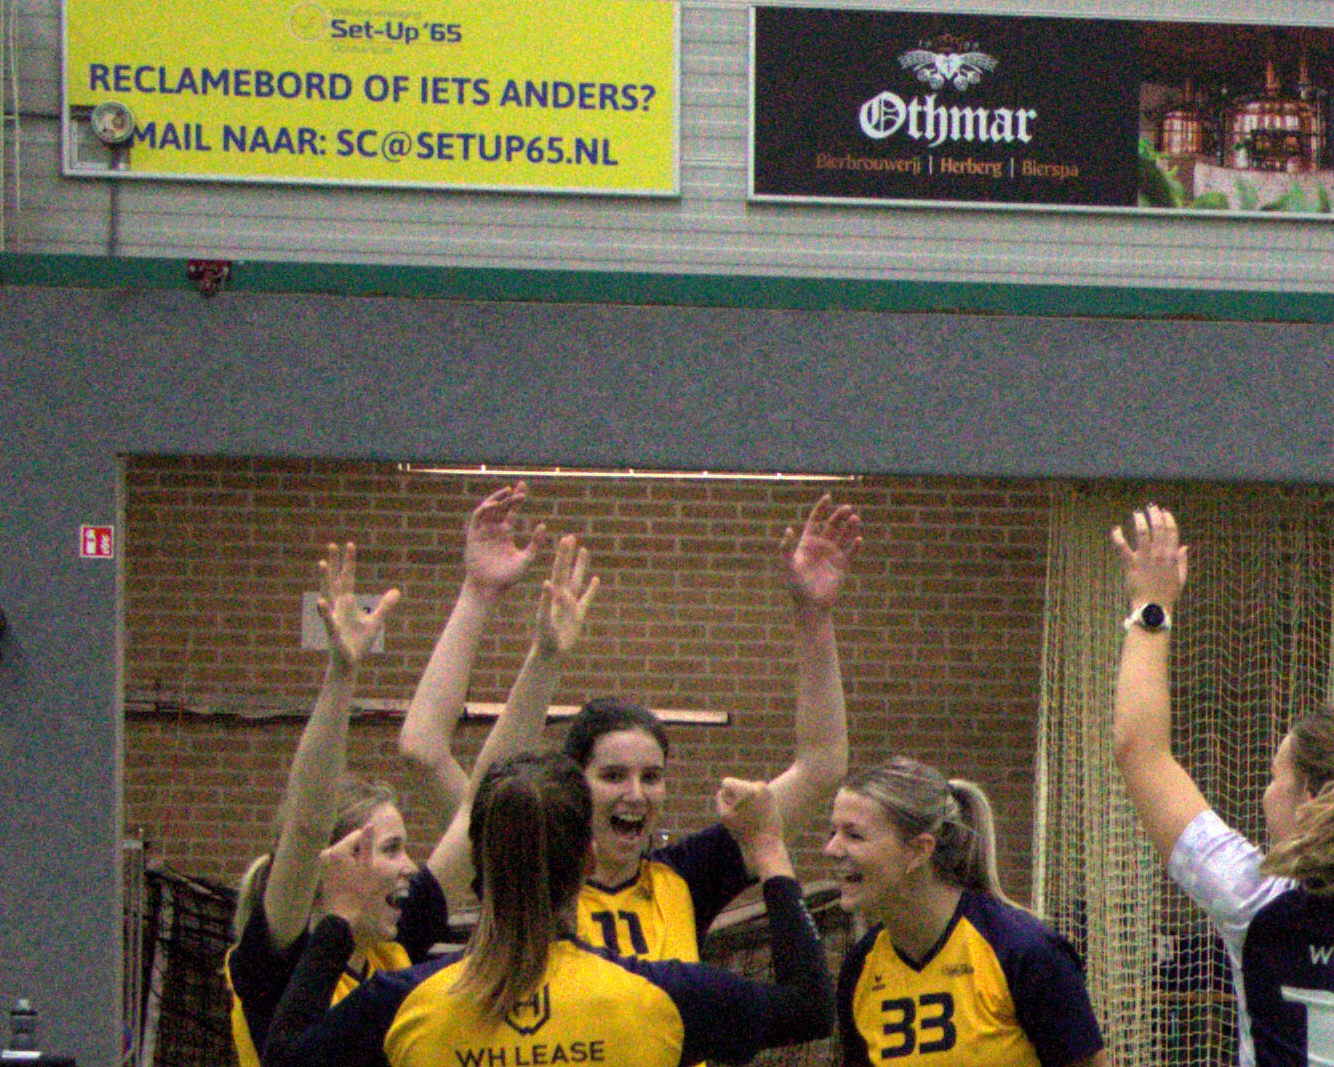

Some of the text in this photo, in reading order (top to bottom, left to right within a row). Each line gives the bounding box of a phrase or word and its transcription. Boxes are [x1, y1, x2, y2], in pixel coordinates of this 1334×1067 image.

[330, 18, 420, 44] Set-Up
[88, 63, 656, 113] RECLAMEBORD OF IETS ANDERS?
[858, 90, 1038, 148] Othmar
[222, 124, 326, 156] NAAR:
[336, 128, 619, 166] SC@SETUP65.NL
[816, 153, 1080, 180] Bierbrouwerij Herberg Bierspa
[590, 909, 650, 954] 11
[881, 991, 957, 1060] 33
[514, 1040, 606, 1067] LEASE
